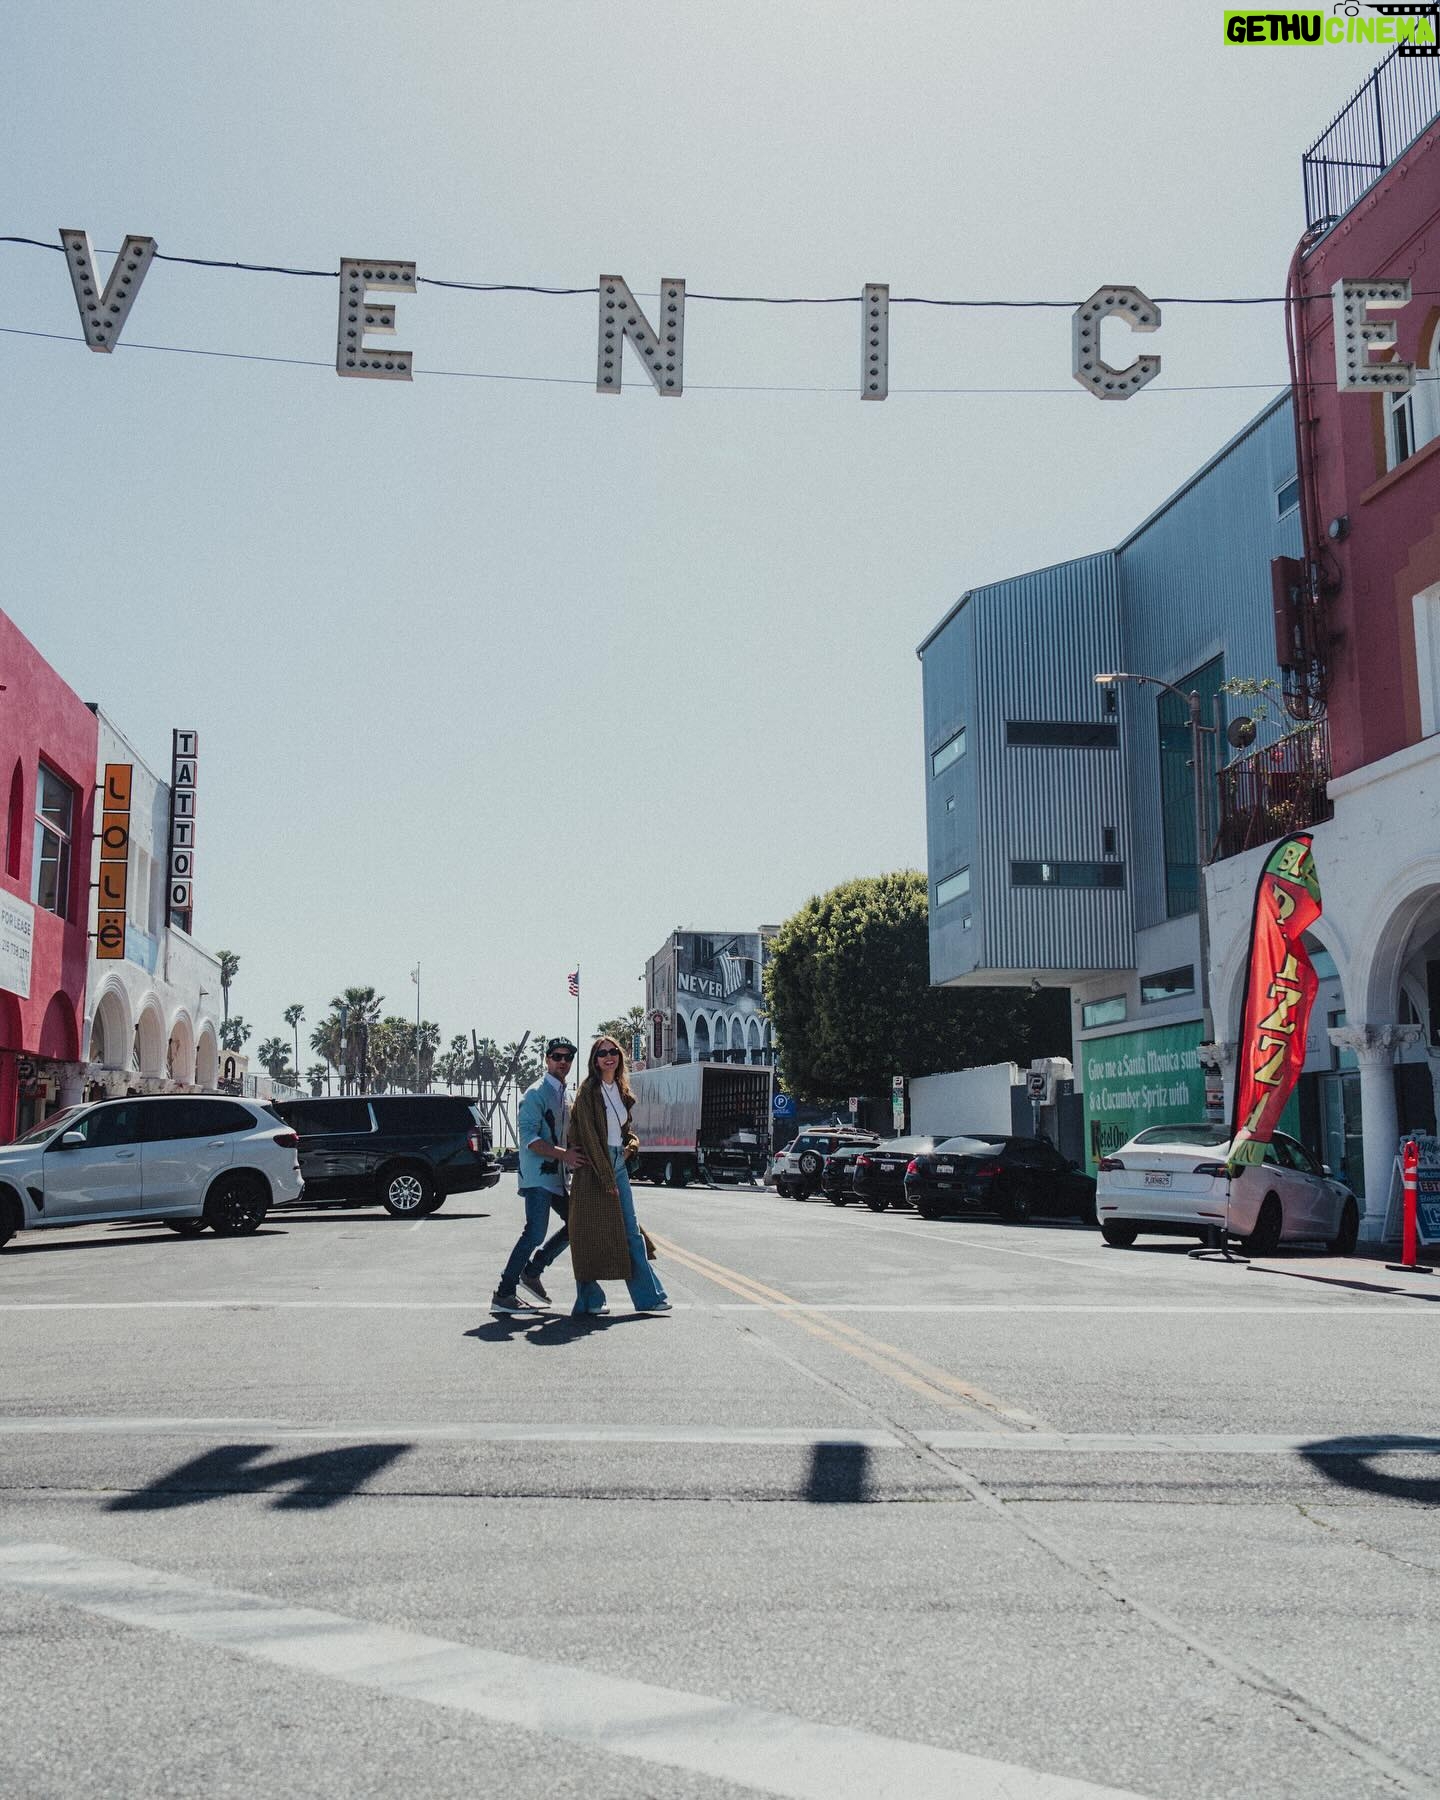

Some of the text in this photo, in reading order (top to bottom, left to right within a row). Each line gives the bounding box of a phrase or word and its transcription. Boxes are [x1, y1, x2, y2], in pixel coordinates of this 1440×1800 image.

[59, 228, 1417, 401] VENICE
[172, 733, 193, 904] TATTOO
[1, 909, 14, 928] FOR
[14, 915, 31, 936] LEASE
[678, 972, 723, 998] NEVER
[1088, 1058, 1104, 1081] Give
[1105, 1061, 1117, 1079] me
[1117, 1060, 1123, 1077] a
[1123, 1053, 1146, 1076] Santa
[1146, 1048, 1180, 1073] Monica
[1102, 1086, 1140, 1110] Cucumber
[1140, 1083, 1168, 1113] Spritz
[1168, 1081, 1189, 1106] with
